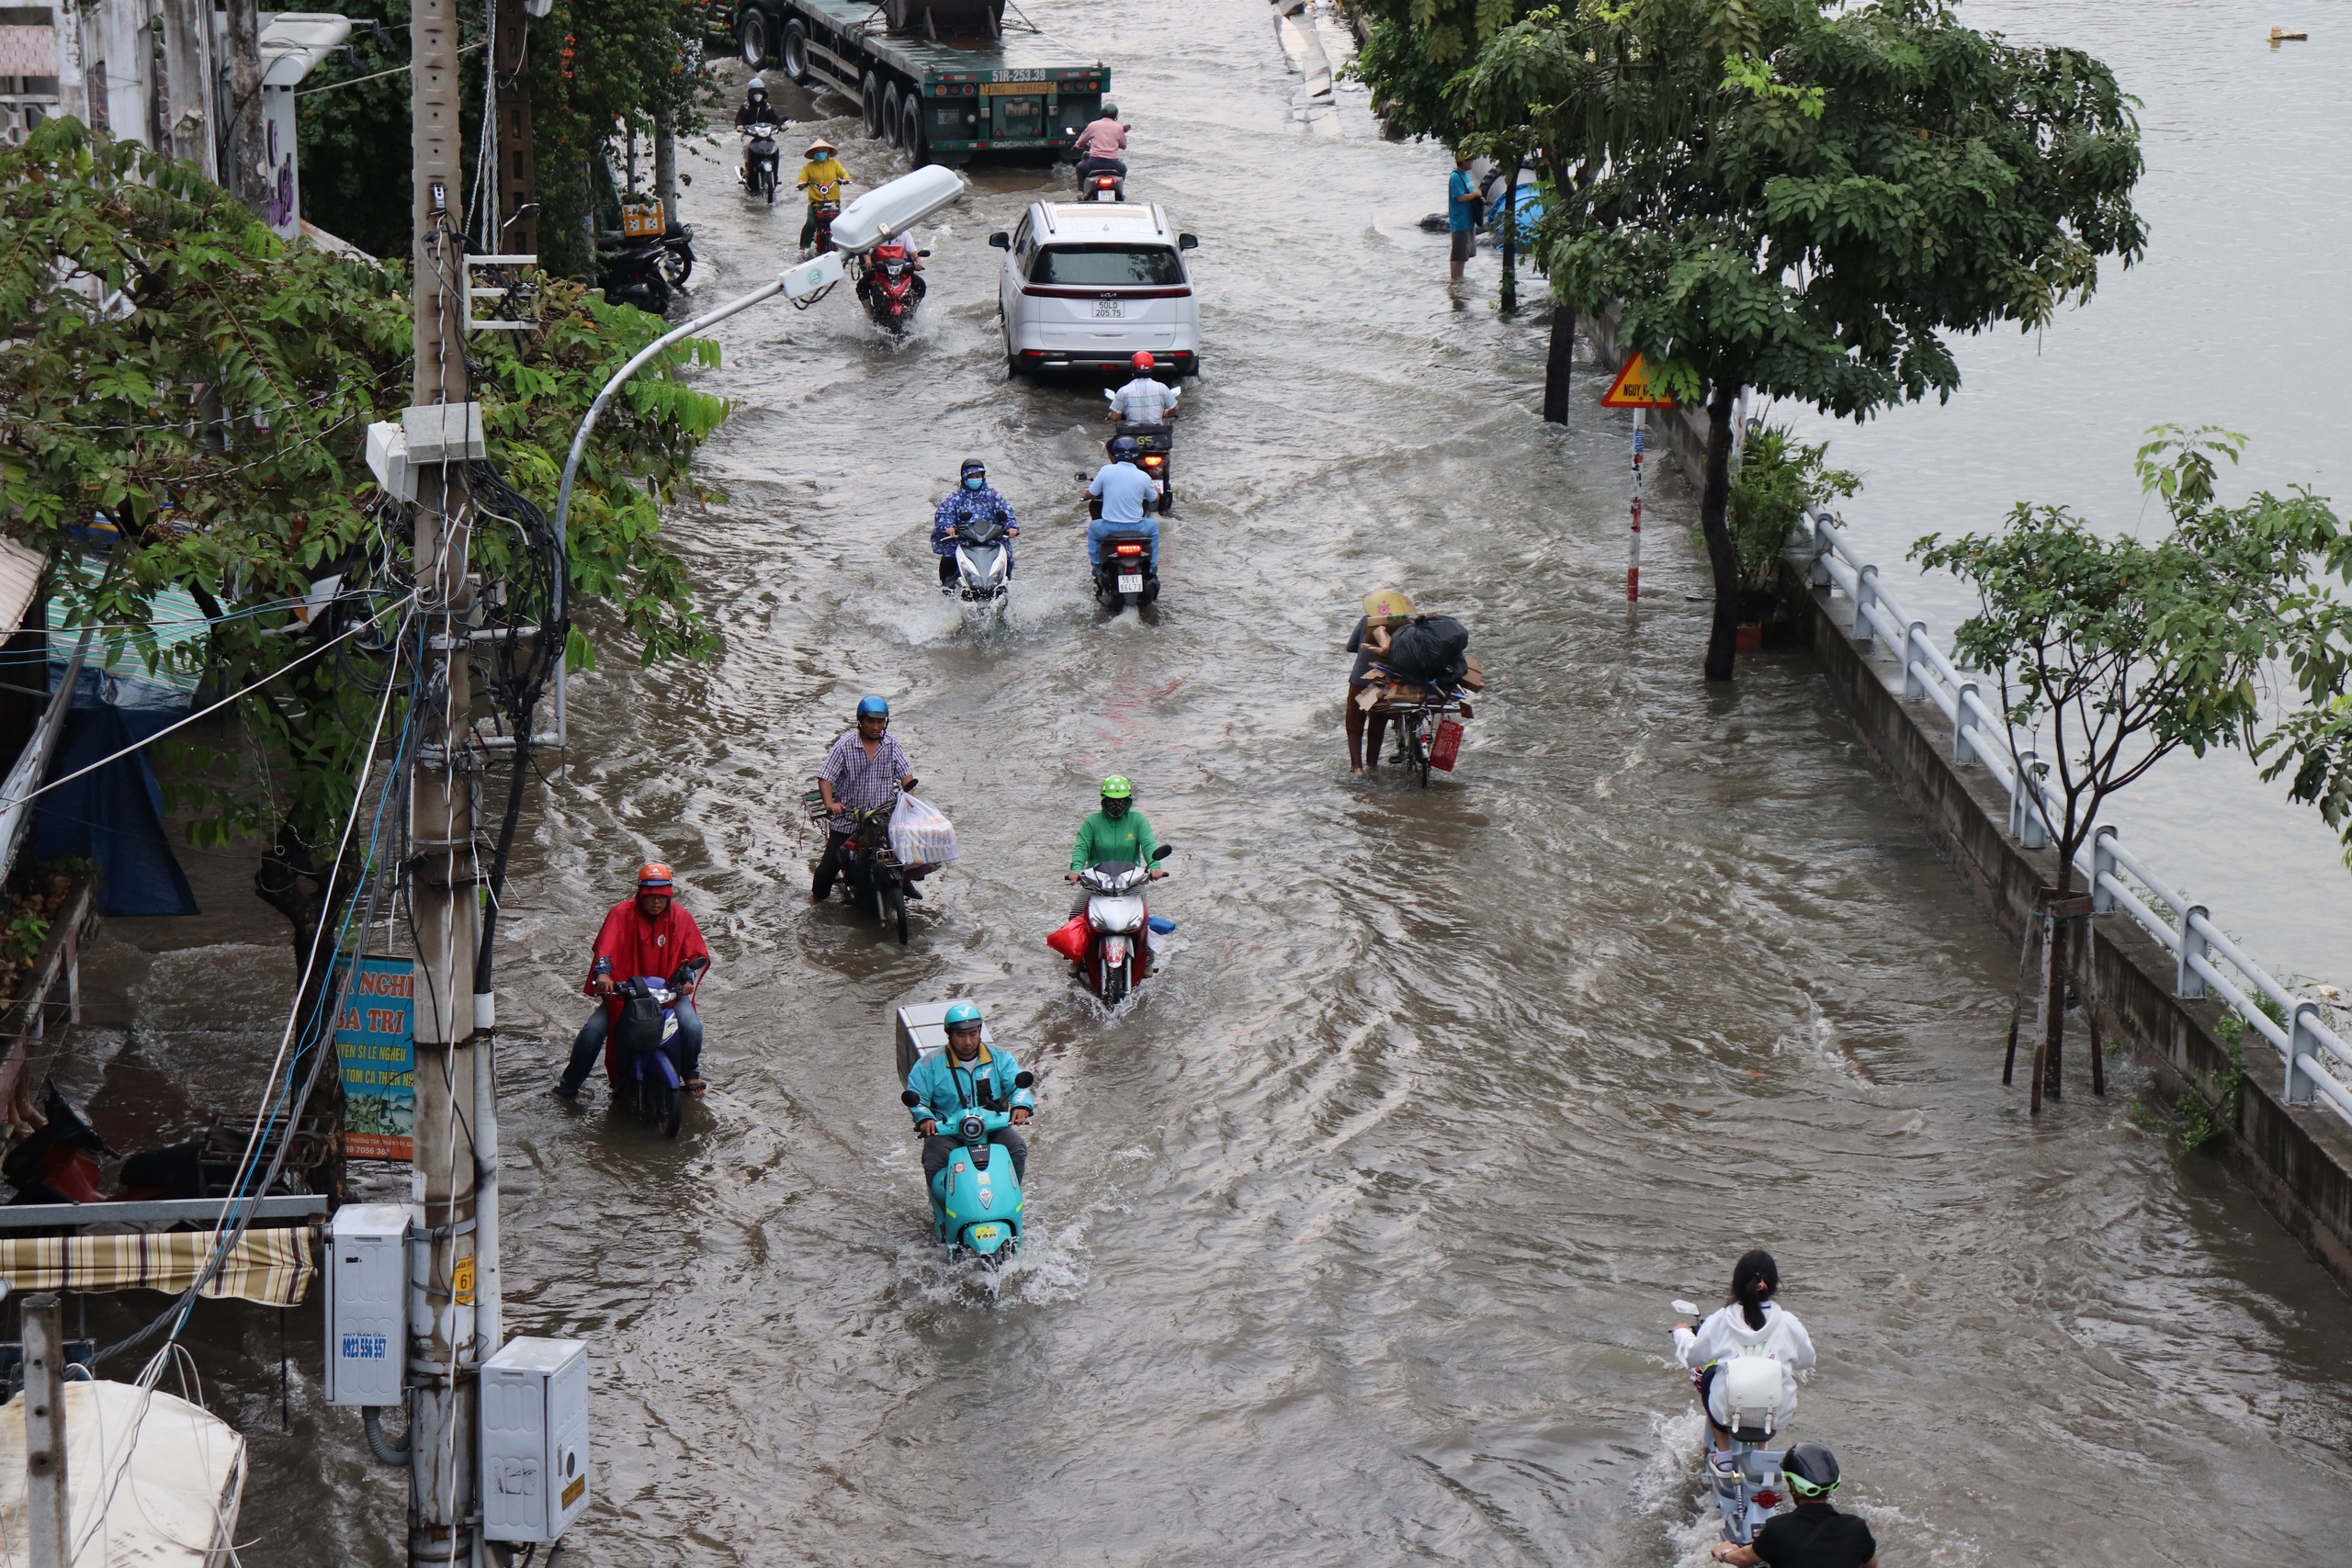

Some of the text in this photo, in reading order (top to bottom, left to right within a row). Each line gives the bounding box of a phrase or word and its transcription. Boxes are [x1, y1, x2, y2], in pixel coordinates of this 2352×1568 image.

[992, 69, 1046, 82] 51R-253.39
[983, 84, 1054, 94] LONG VEHICLE
[1095, 309, 1122, 317] 205.75
[1623, 383, 1641, 396] NGUY
[367, 1008, 405, 1034] TRI
[379, 1044, 406, 1062] NGHÊU
[345, 1066, 363, 1084] TÔM
[365, 1067, 376, 1084] CÁ
[378, 1069, 401, 1087] THIÊN
[356, 1146, 375, 1155] 7056
[460, 1272, 472, 1289] 61
